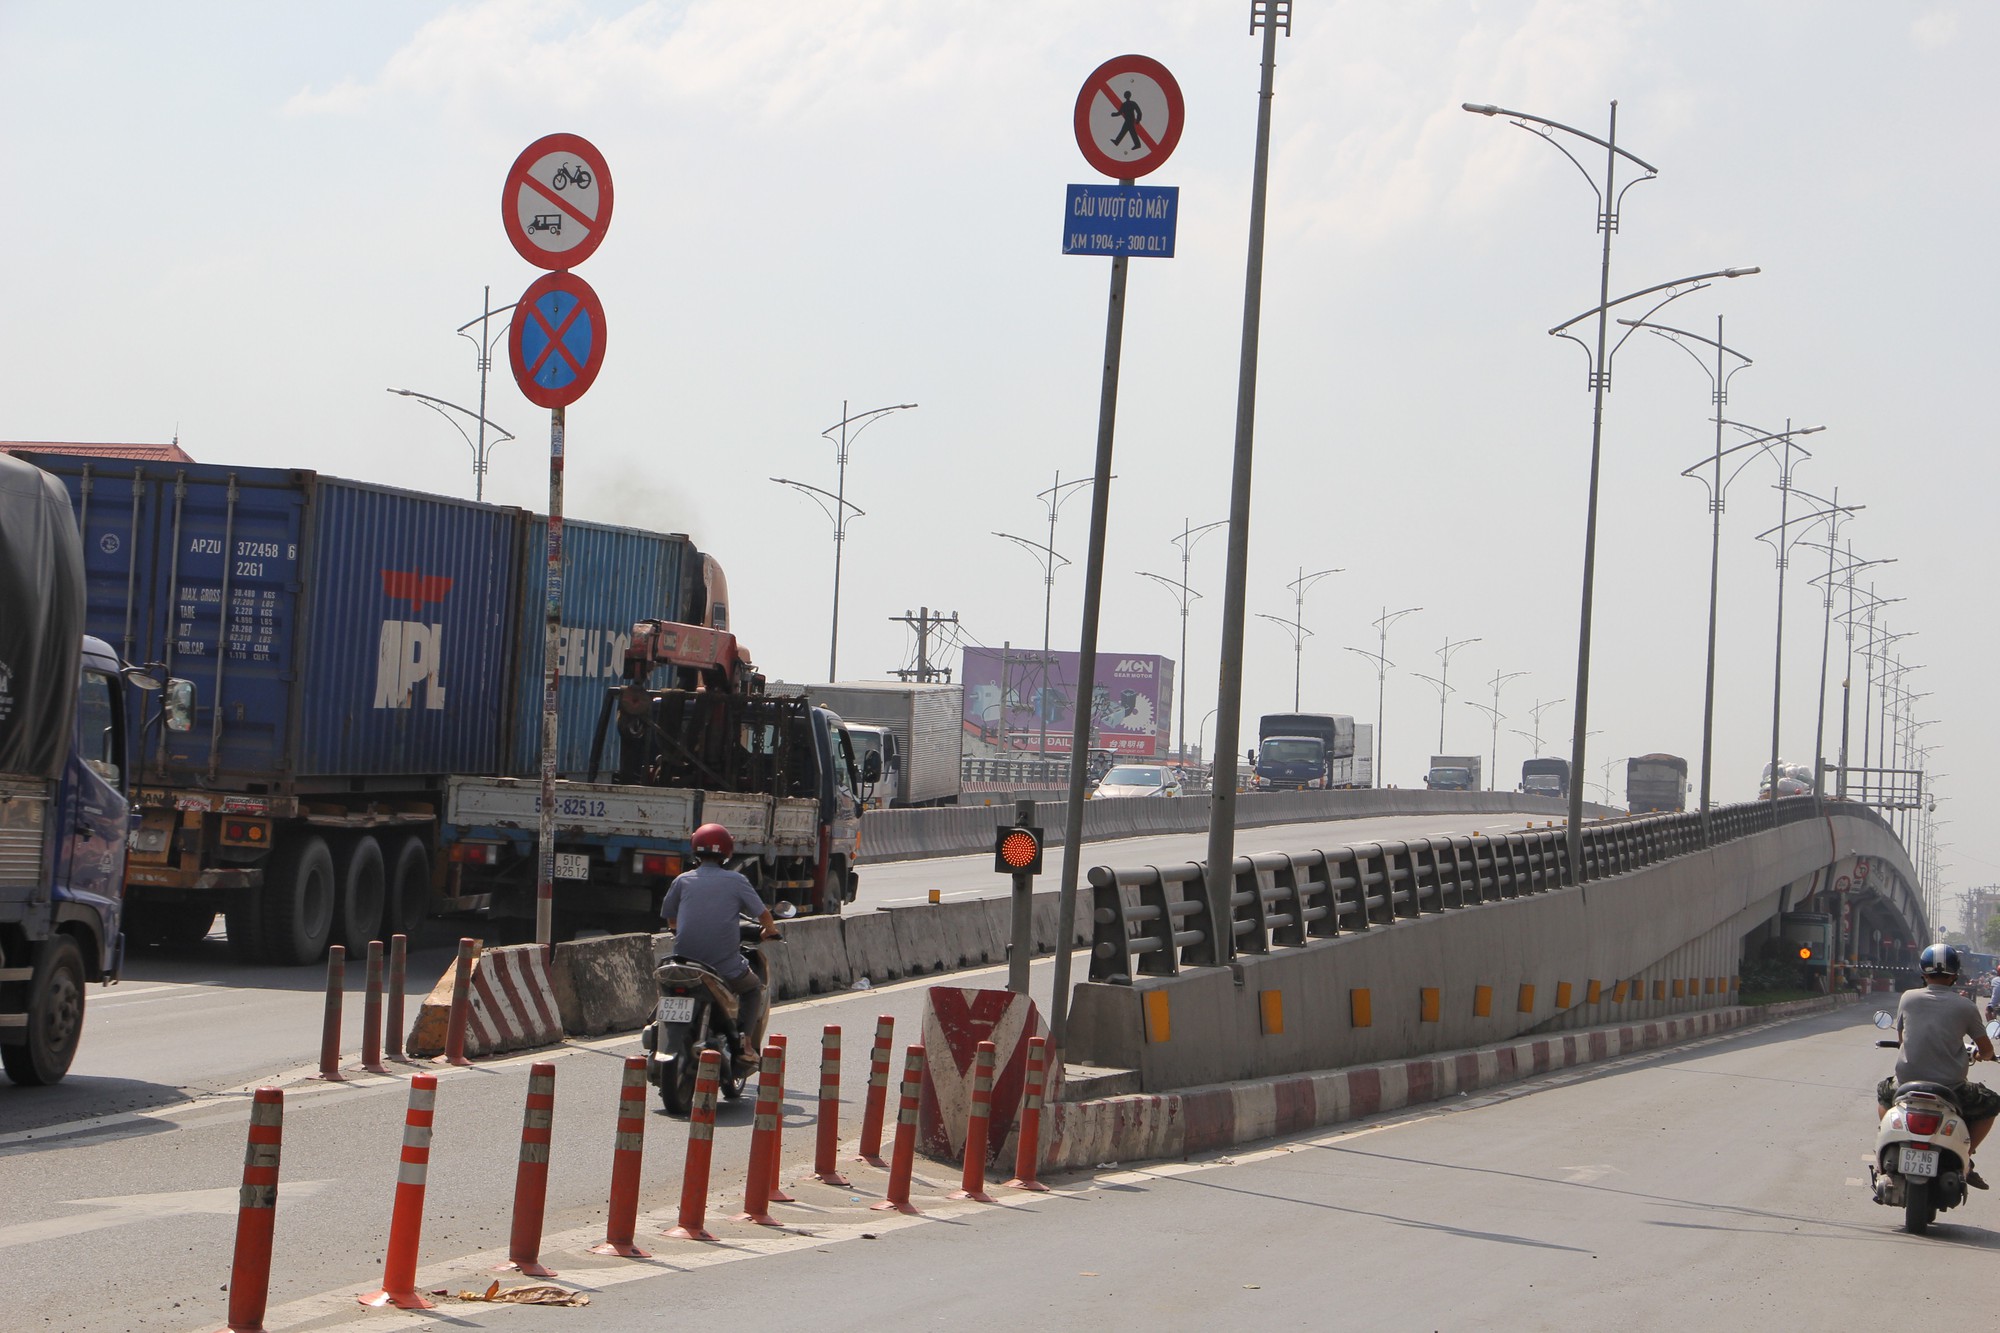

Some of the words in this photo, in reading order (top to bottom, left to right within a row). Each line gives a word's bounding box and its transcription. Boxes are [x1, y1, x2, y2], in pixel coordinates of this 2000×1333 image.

[1074, 189, 1095, 216] CẦU
[1098, 196, 1126, 220] VƯỢT
[1128, 193, 1143, 218] GÒ
[1146, 195, 1169, 219] MÂY
[1071, 233, 1087, 249] KM
[1091, 234, 1113, 249] 1904
[1128, 235, 1145, 251] 300
[1147, 236, 1166, 251] QL1
[190, 539, 221, 554] APZU
[237, 542, 278, 557] 372458
[287, 544, 296, 560] 6
[236, 562, 263, 576] 22G1
[182, 587, 197, 601] MAX.
[201, 588, 221, 602] GROSS
[263, 591, 276, 599] KGS
[180, 605, 196, 619] TARE
[261, 608, 273, 617] KGS
[179, 623, 192, 636] NET
[260, 627, 273, 635] KGS
[373, 619, 446, 710] APL
[535, 797, 606, 817] 5-82512
[563, 855, 581, 867] 51C
[556, 866, 587, 879] 825.12
[1904, 1162, 1931, 1174] 0765
